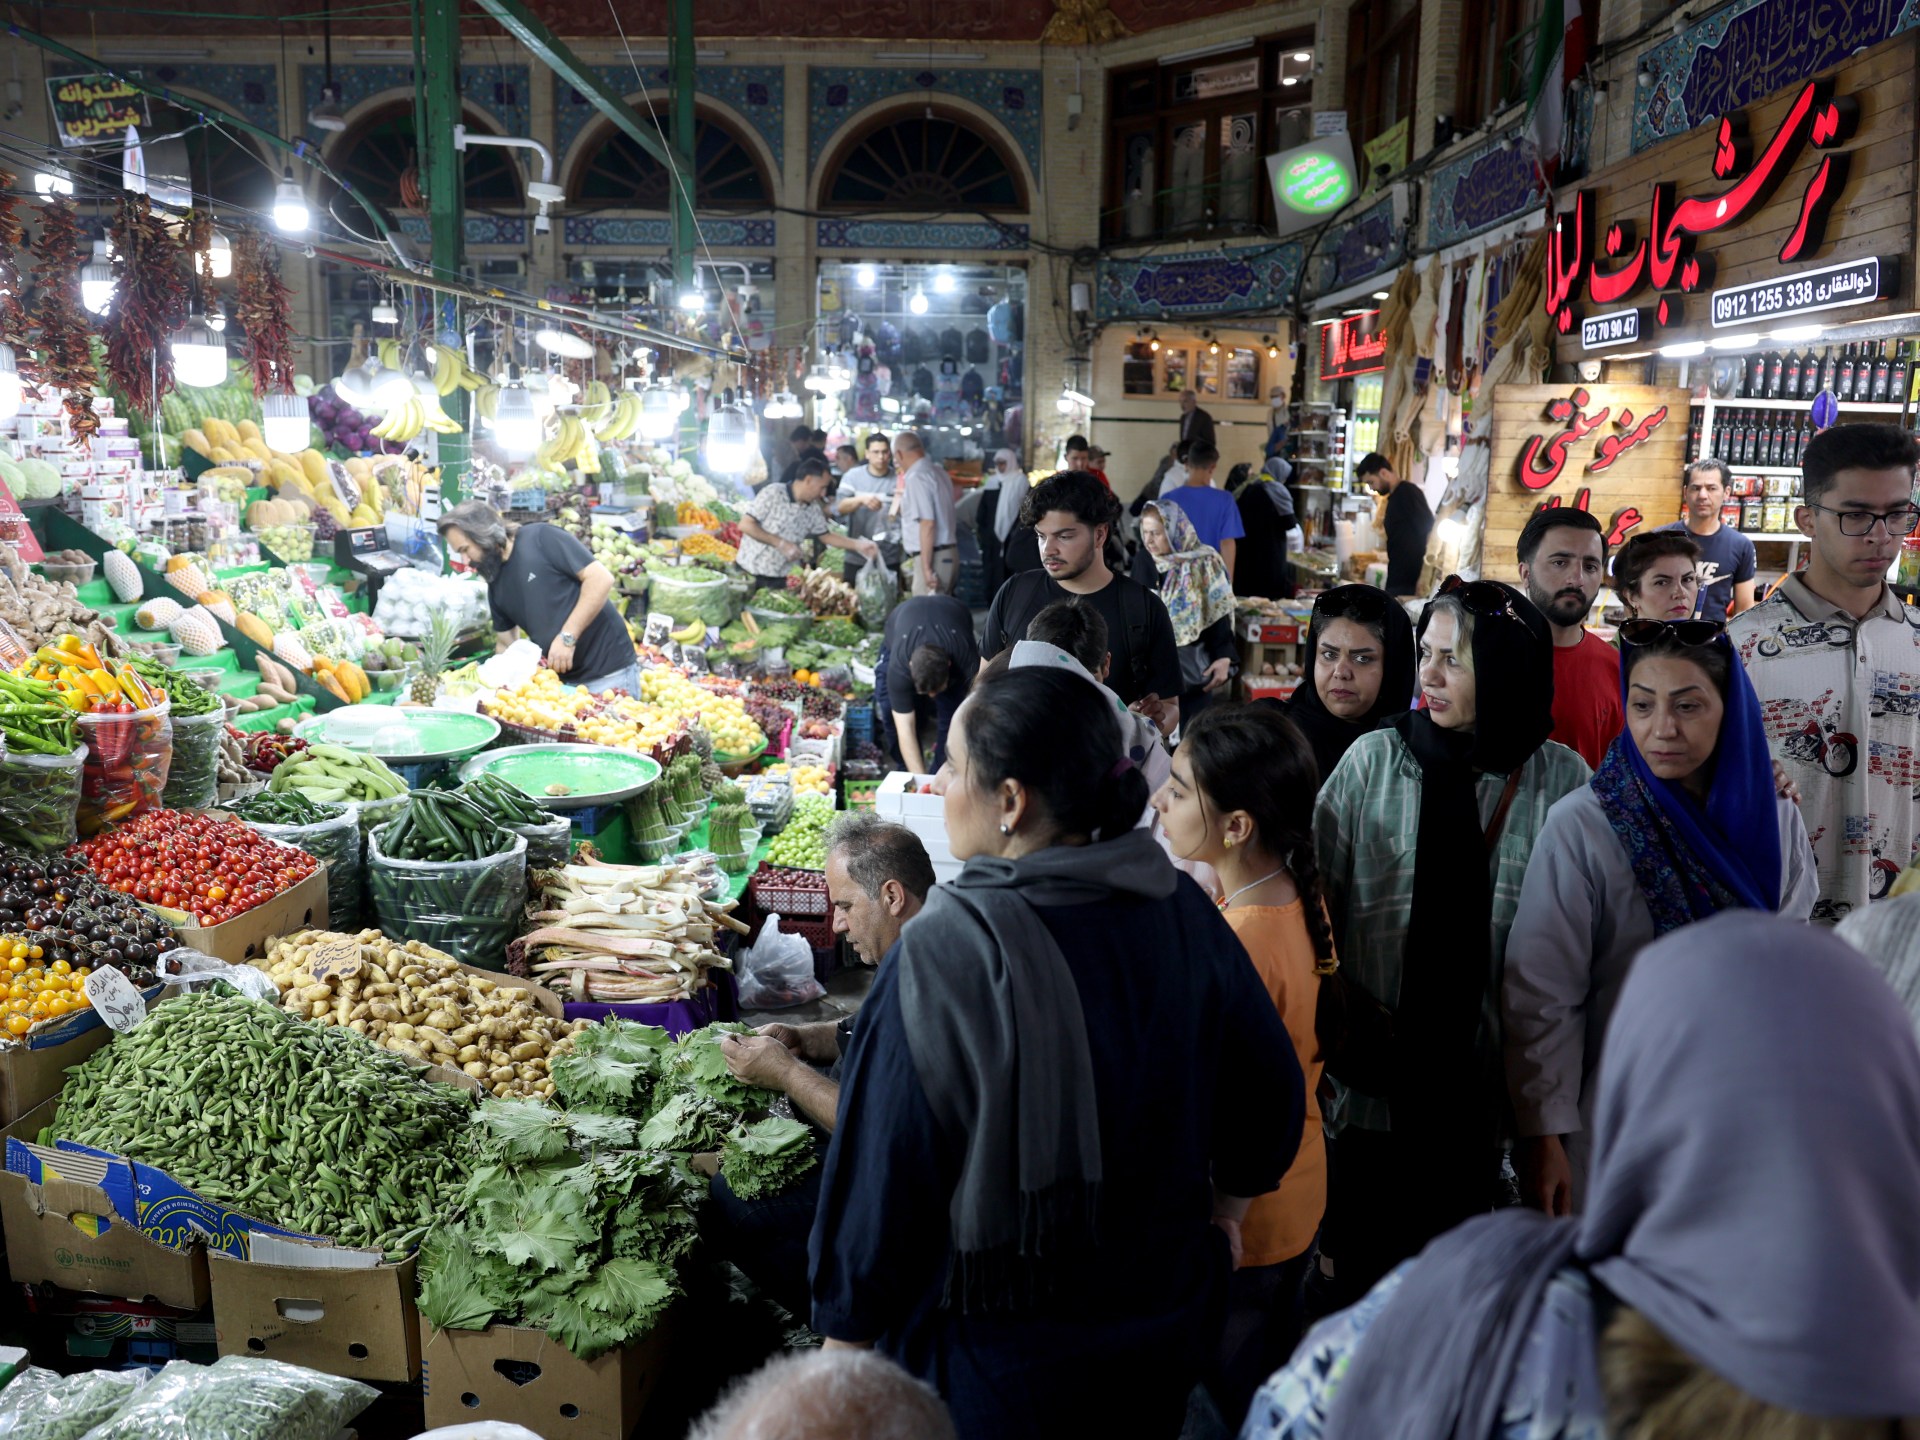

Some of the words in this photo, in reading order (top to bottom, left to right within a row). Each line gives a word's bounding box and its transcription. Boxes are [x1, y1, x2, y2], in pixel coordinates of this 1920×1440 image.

[65, 106, 141, 138] شیرین
[1588, 82, 1840, 327] ترشیجات
[1546, 189, 1584, 335] لیلا
[1717, 298, 1747, 320] 0912
[1750, 288, 1783, 313] 1255
[1786, 280, 1813, 307] 338
[1815, 267, 1872, 303] ذوالفقاری
[1585, 324, 1597, 343] 22
[1598, 321, 1610, 340] 70
[1611, 319, 1622, 338] 90
[1623, 316, 1636, 335] 47
[1520, 387, 1609, 491] سنتی
[1589, 405, 1667, 472] سمنو
[149, 1203, 170, 1225] BANANAS
[171, 1201, 199, 1211] PREMIUM
[75, 1252, 131, 1269] Bandhan
